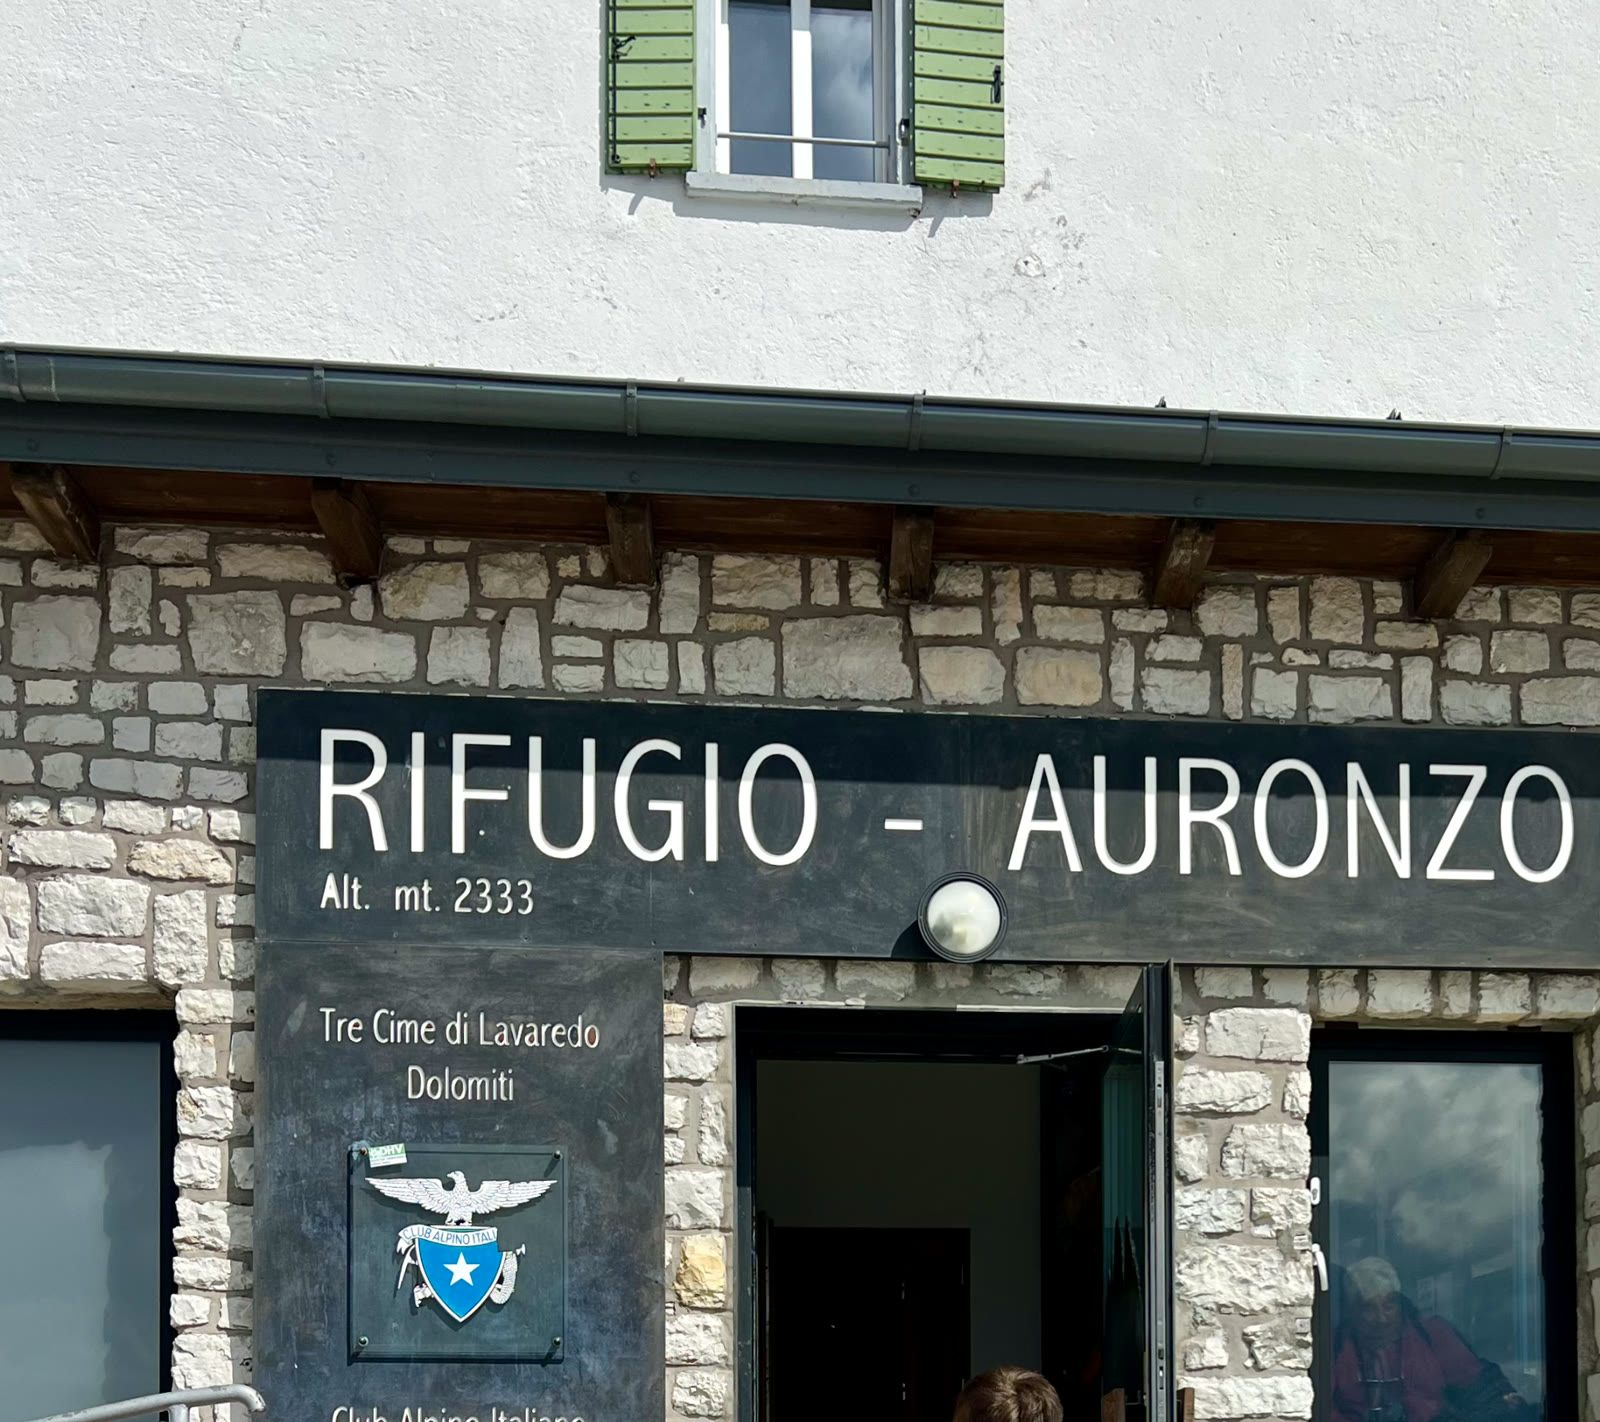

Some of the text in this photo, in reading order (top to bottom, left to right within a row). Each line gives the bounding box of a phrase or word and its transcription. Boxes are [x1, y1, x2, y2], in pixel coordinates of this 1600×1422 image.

[318, 727, 1575, 884] RIFUGIO - AURONZO
[319, 871, 535, 915] Alt. mt. 2333
[319, 1007, 600, 1048] Tre Cime di Lavaredo
[407, 1065, 515, 1102] Dolomiti
[402, 1226, 432, 1240] CLUB
[433, 1231, 471, 1246] ALPINO
